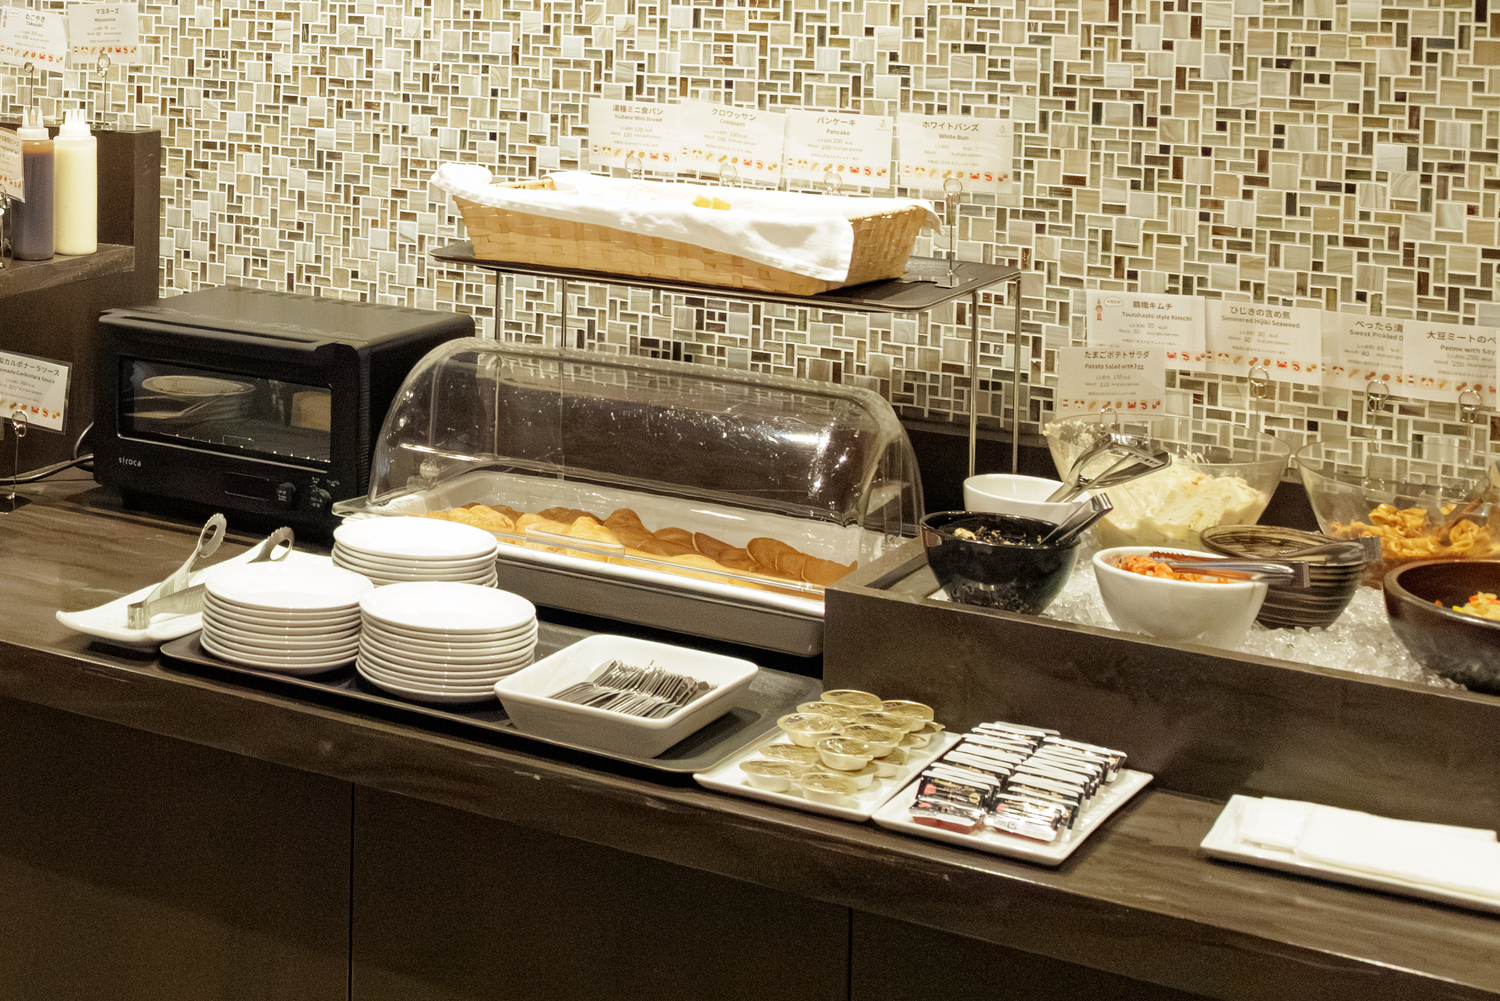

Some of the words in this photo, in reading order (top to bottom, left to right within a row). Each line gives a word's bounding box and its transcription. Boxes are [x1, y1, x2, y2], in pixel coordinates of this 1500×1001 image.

[95, 7, 120, 15] マヨネーズ
[614, 113, 634, 121] Yudane
[646, 115, 663, 123] Bread
[711, 108, 757, 121] クロワッサン
[719, 118, 746, 127] Croissant
[816, 116, 856, 127] パンケーキ
[922, 121, 980, 132] ホワイトバンズ
[826, 128, 851, 136] Pancake
[1230, 306, 1291, 320] ひじきの含め煮
[1221, 315, 1254, 324] Simmered
[1254, 318, 1271, 326] Hijiki
[1271, 320, 1301, 329] Seaweed
[1349, 329, 1371, 337] Sweet
[1372, 332, 1398, 340] Pickled
[1440, 344, 1463, 353] Penne
[1084, 350, 1150, 359] たまごポテトサラダ
[16, 370, 41, 380] Carbonara
[118, 456, 142, 467] siroca
